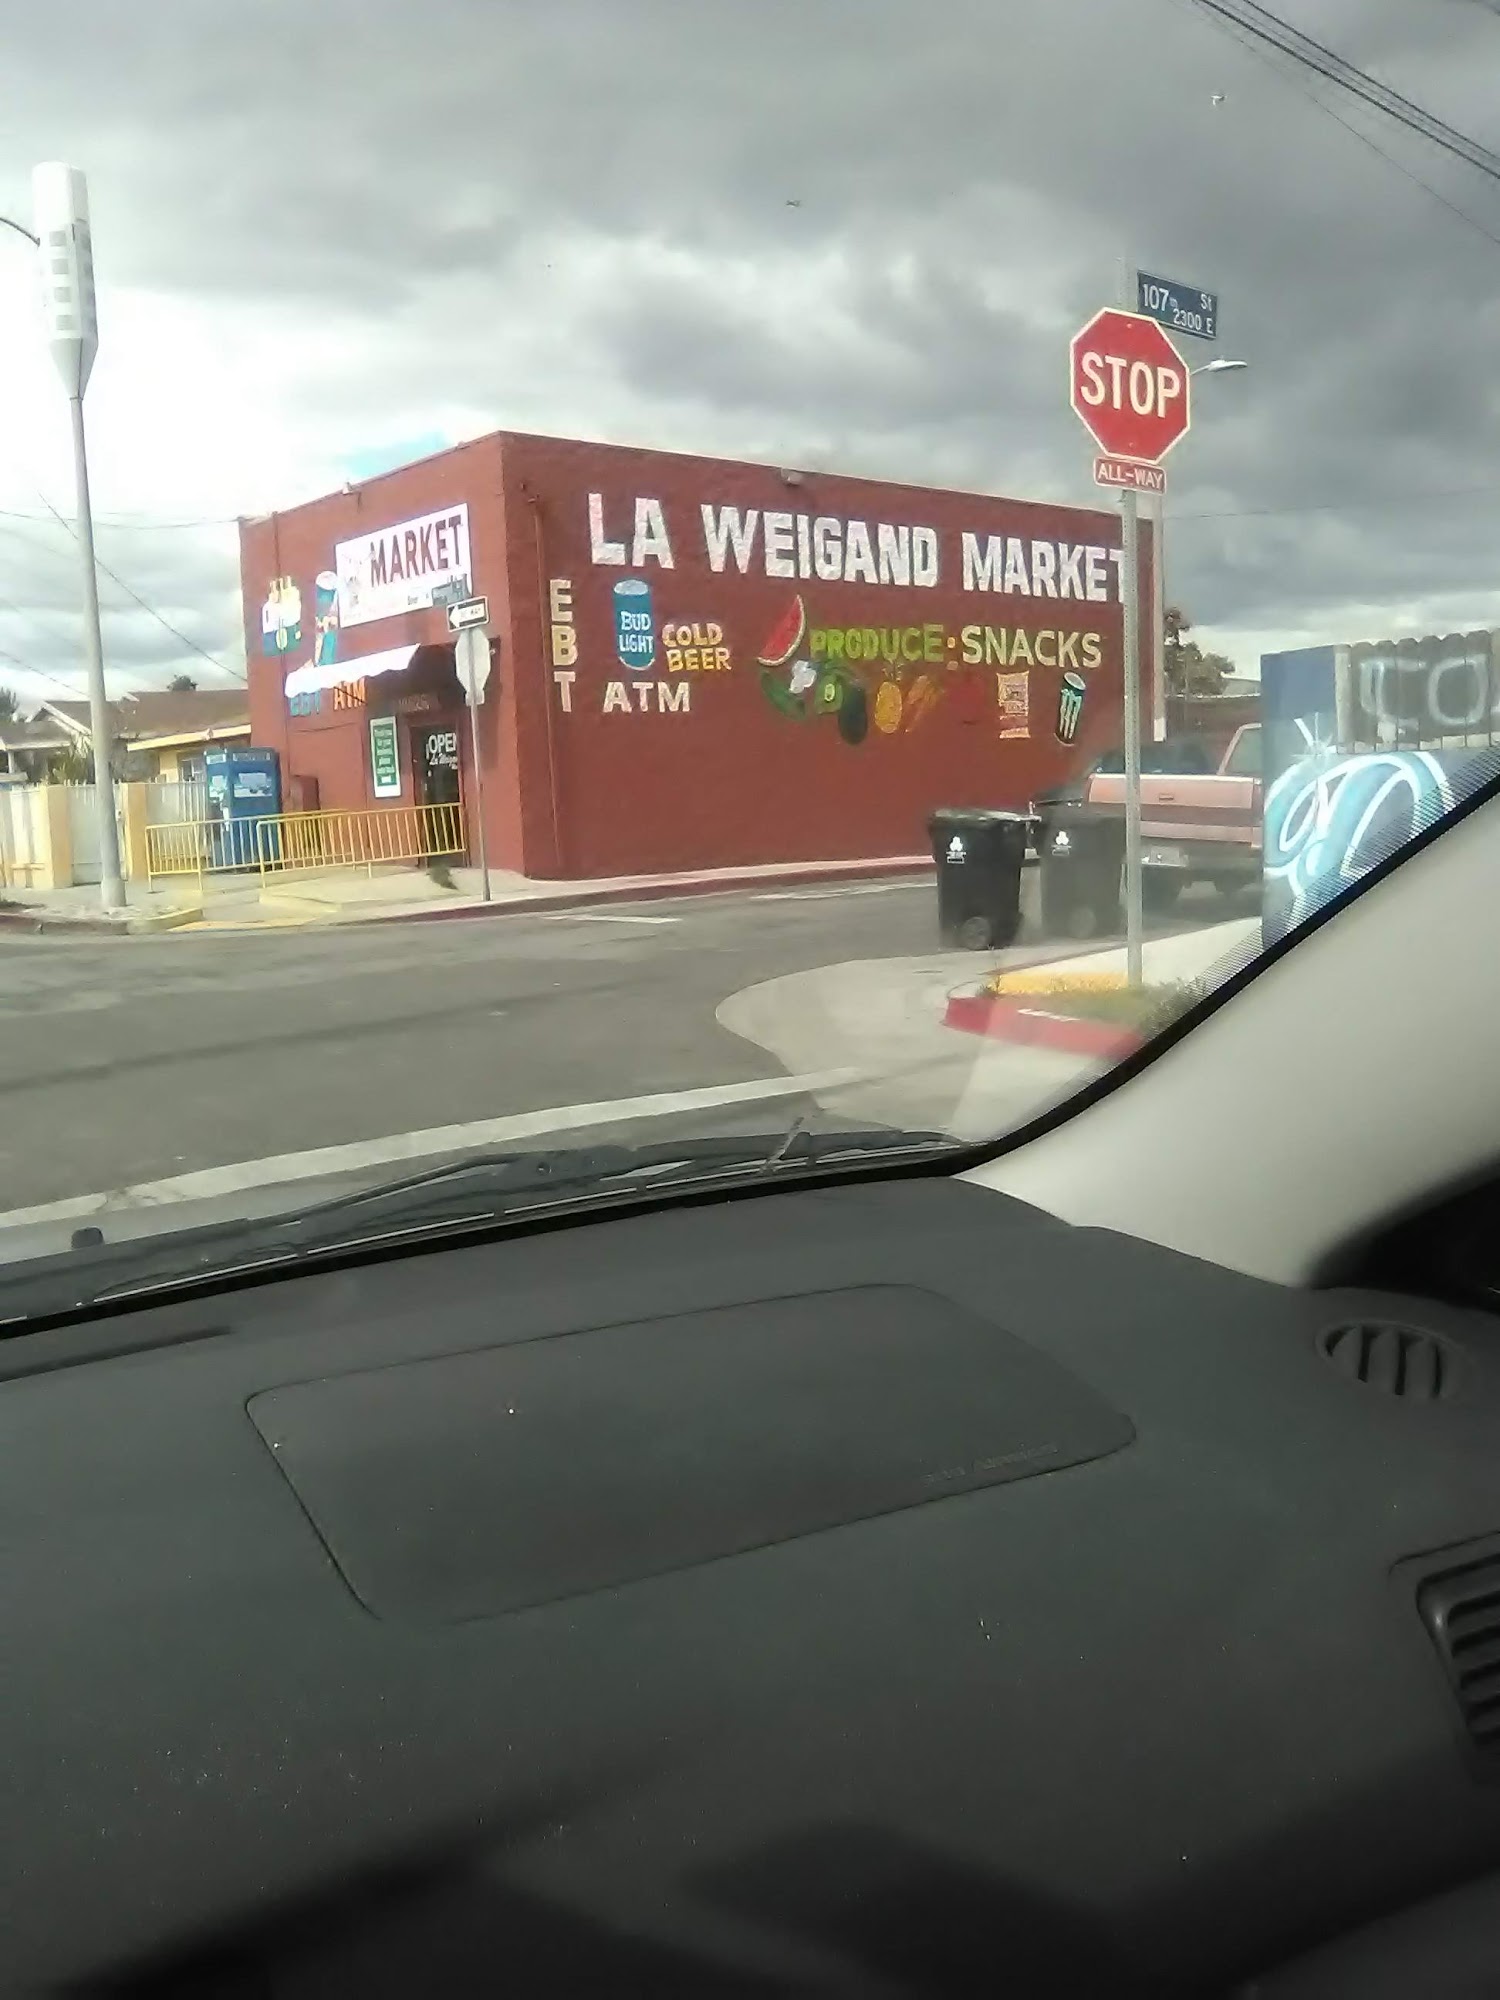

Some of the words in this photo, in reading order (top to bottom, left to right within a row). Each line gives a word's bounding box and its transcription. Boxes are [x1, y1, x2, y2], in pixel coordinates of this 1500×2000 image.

[1173, 308, 1202, 331] 2300
[1206, 317, 1214, 334] E
[1080, 351, 1181, 419] STOP
[1097, 462, 1164, 490] ALL-WAY
[370, 514, 462, 588] MARKET
[588, 491, 676, 570] LA
[700, 503, 939, 589] WEIGAND
[961, 531, 1125, 604] MARKET
[620, 610, 651, 631] BUD
[661, 622, 723, 648] COLD
[618, 634, 654, 654] LIGHT
[809, 622, 944, 663] PRODUCE
[960, 624, 1103, 669] SNACKS
[666, 647, 732, 672] BEER
[333, 676, 367, 710] ATM
[602, 681, 691, 713] ATM
